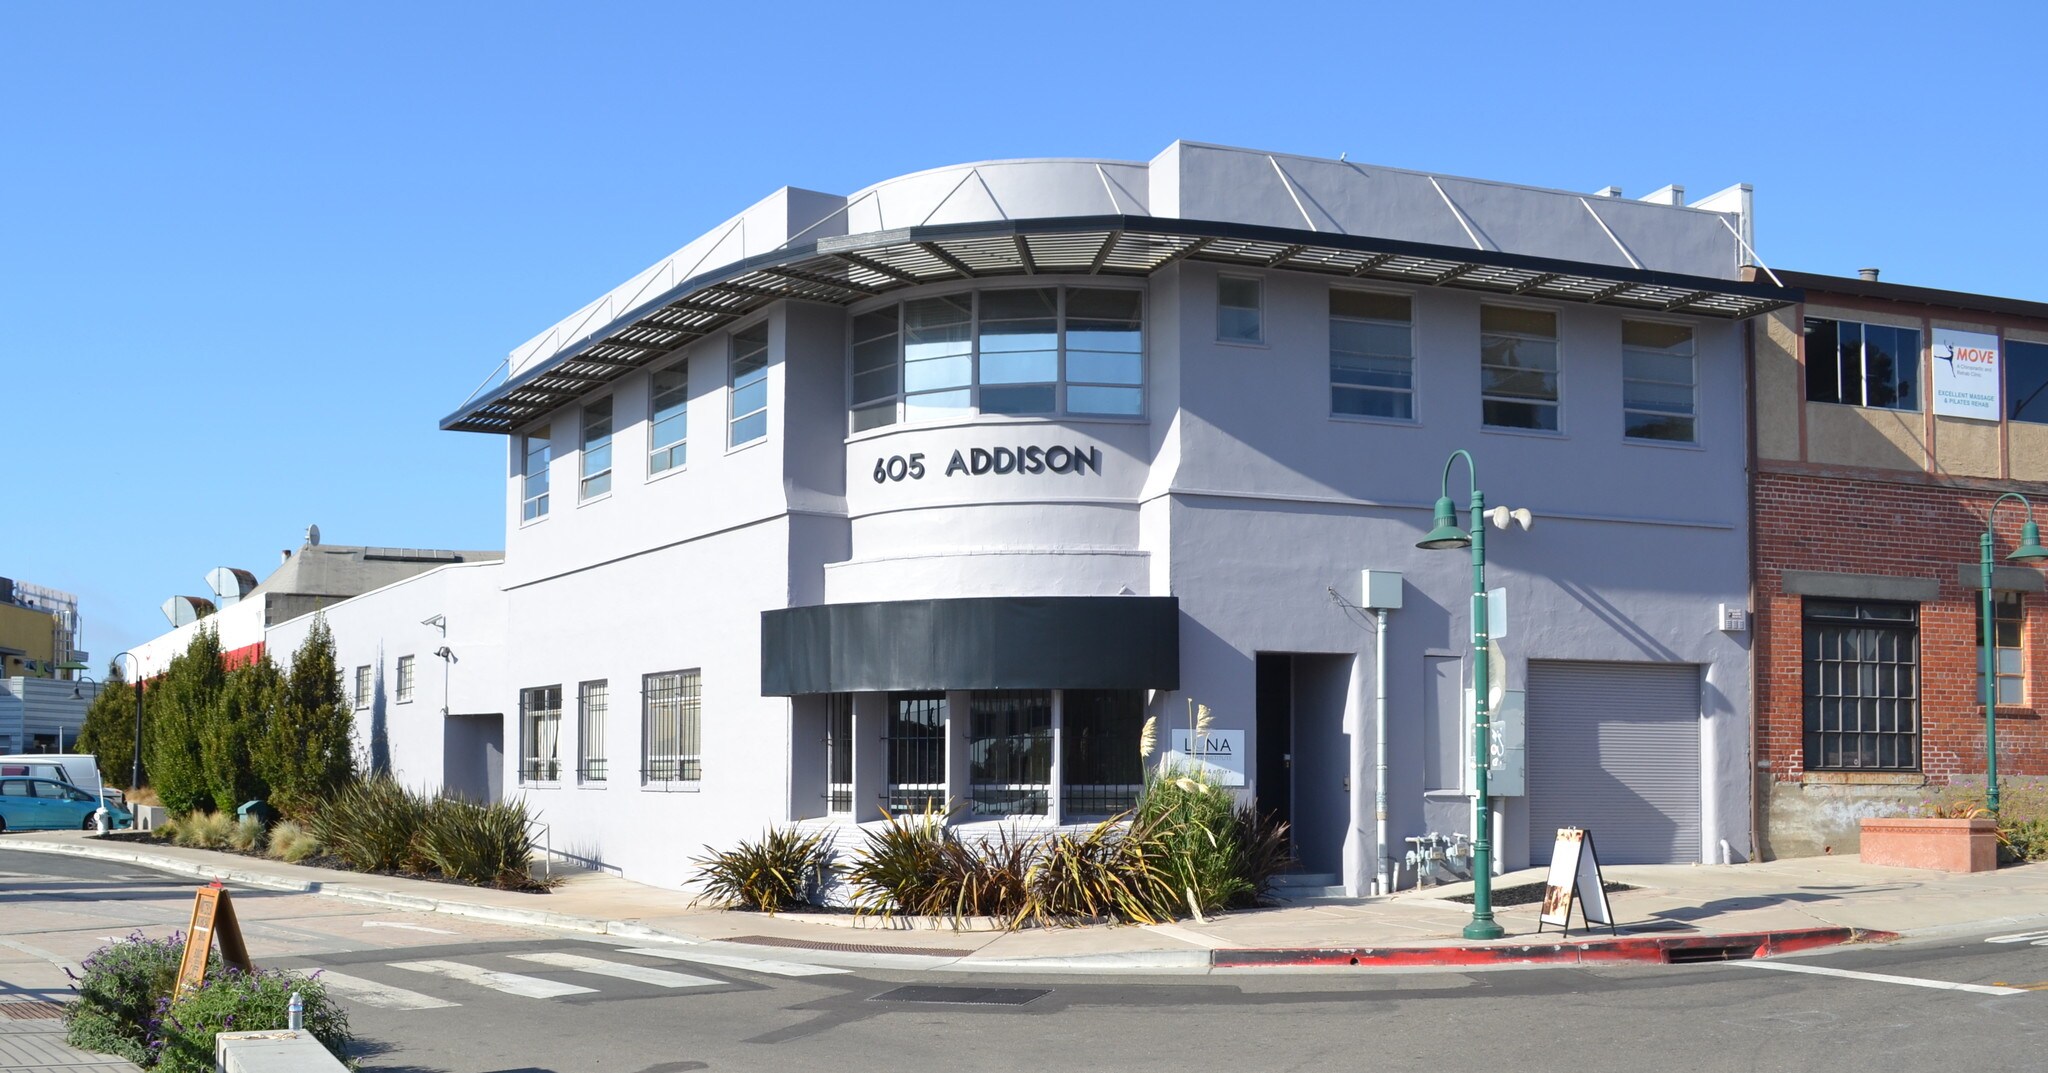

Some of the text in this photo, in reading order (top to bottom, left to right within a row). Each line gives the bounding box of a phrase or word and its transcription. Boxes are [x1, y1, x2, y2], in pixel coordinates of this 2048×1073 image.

[1956, 347, 1993, 364] MOVE
[1938, 390, 1995, 401] EXCELLENT MASSAGE
[1949, 398, 1970, 406] PILATES
[873, 445, 1098, 484] 605 ADDISON
